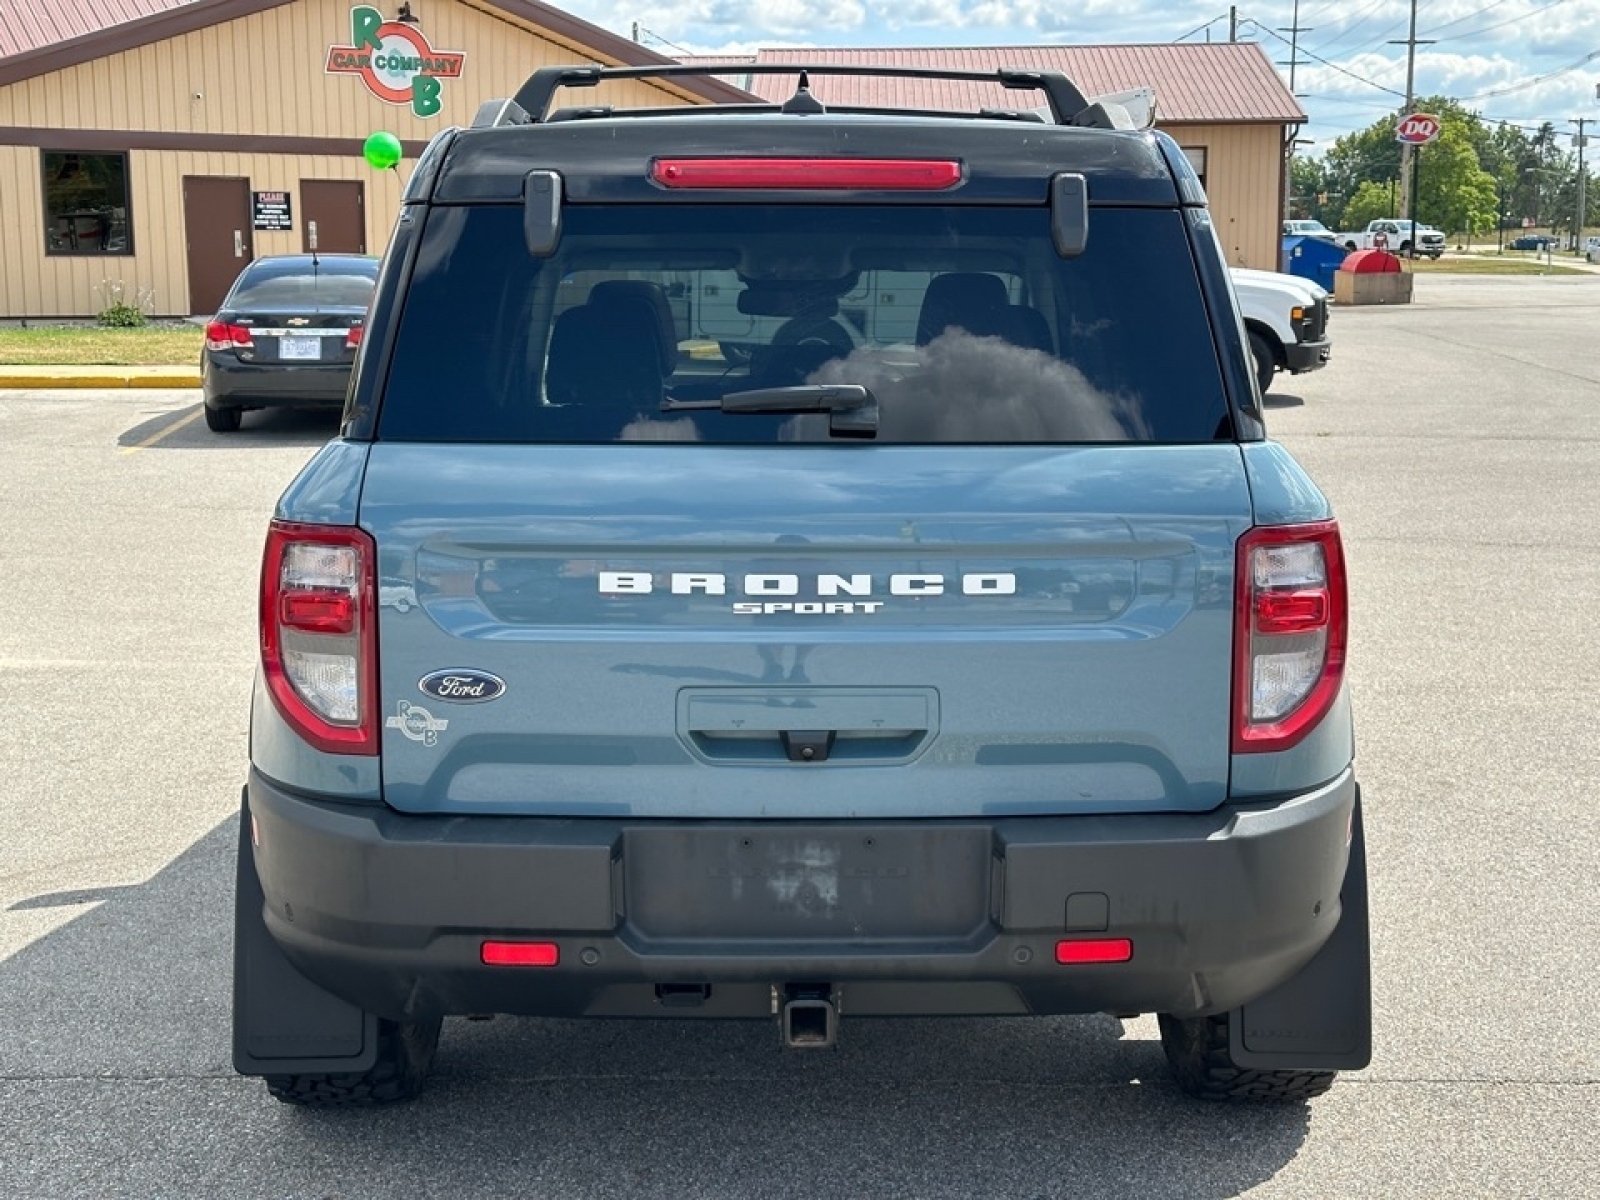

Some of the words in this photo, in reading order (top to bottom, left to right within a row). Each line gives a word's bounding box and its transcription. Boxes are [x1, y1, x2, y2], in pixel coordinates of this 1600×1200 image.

[352, 6, 383, 50] R
[333, 53, 371, 68] CAR
[374, 55, 459, 73] COMPANY
[412, 75, 441, 117] B
[1405, 120, 1434, 136] DQ
[598, 572, 1016, 596] BRONCO
[732, 602, 884, 614] SPORT
[438, 676, 486, 696] Ford
